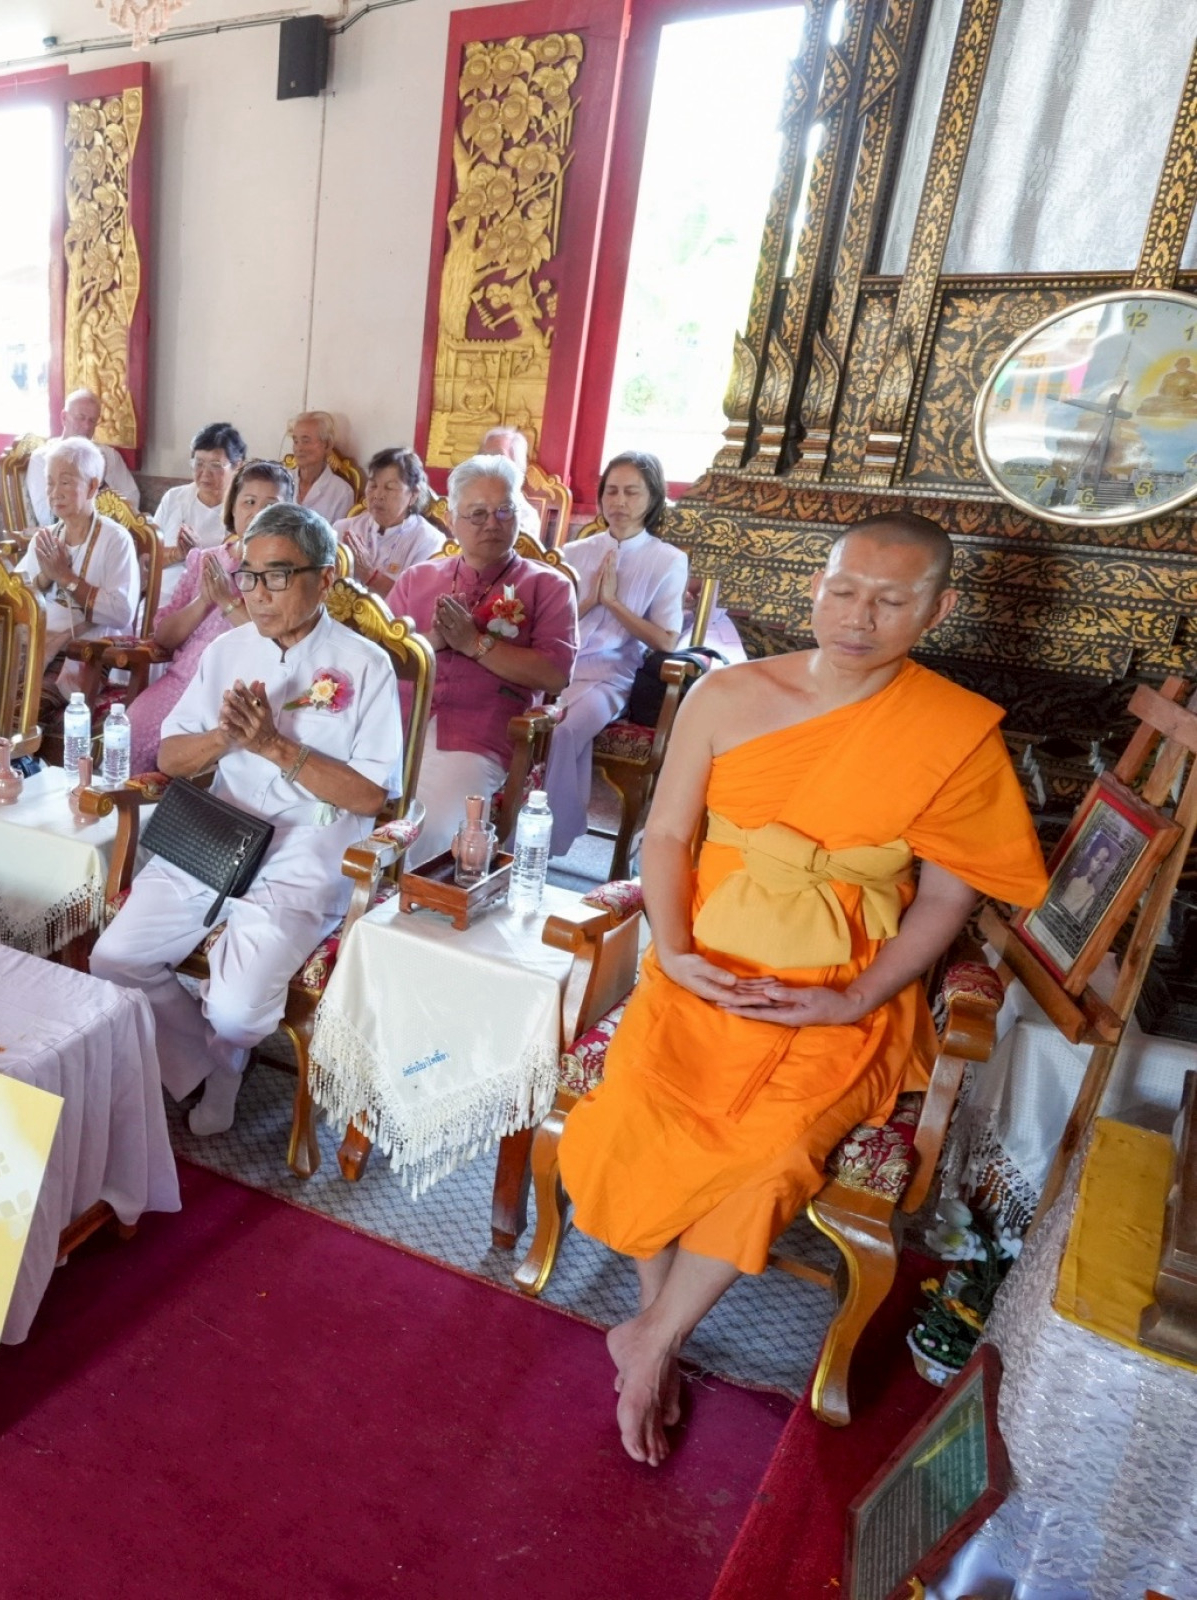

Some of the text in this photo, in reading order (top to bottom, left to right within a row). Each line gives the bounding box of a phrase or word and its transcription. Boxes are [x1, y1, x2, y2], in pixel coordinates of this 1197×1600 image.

[1126, 311, 1149, 327] 12
[1036, 475, 1049, 489] 7
[1137, 482, 1150, 496] 5
[1081, 489, 1094, 504] 6
